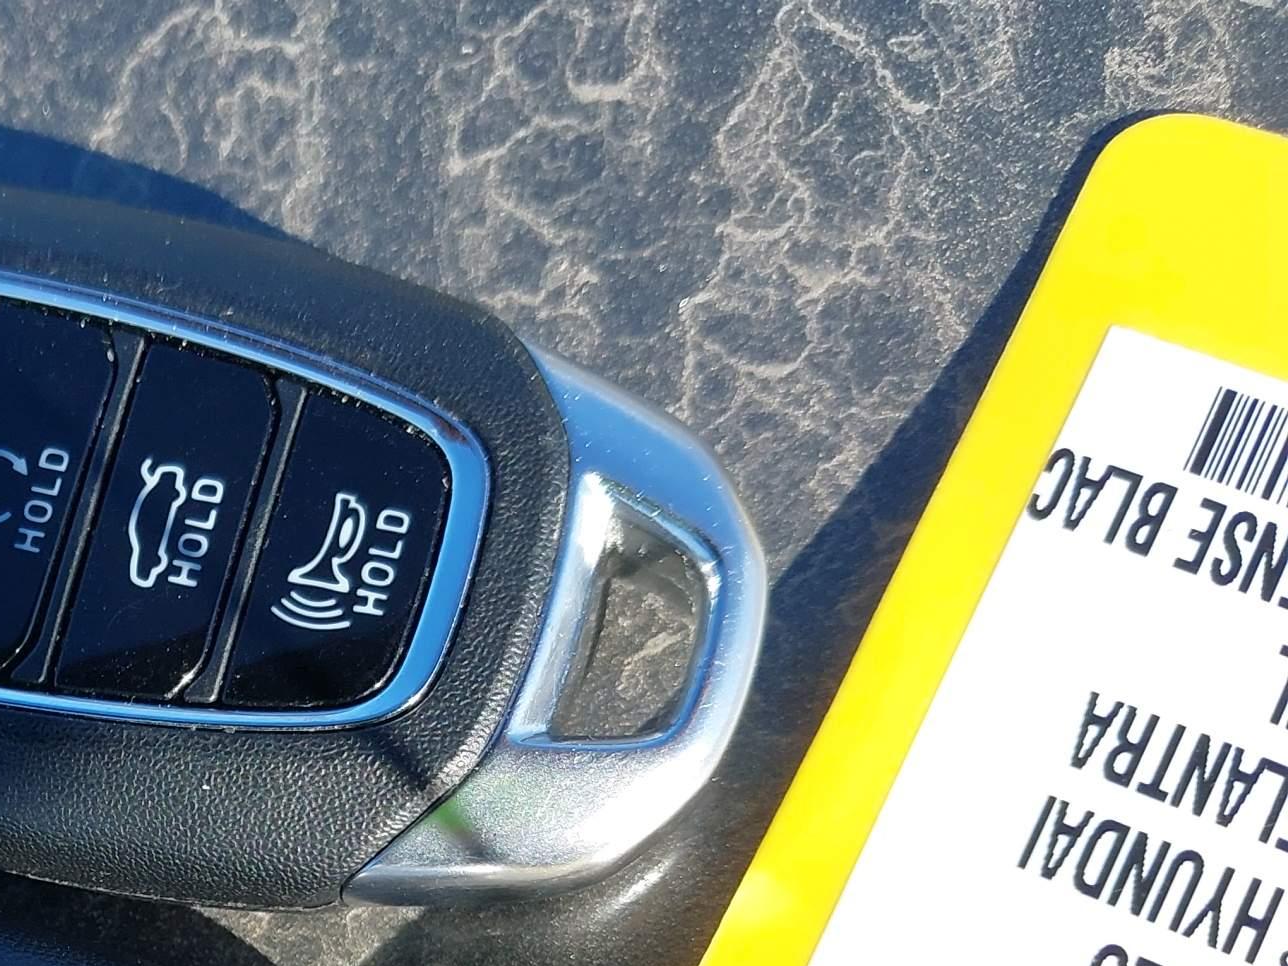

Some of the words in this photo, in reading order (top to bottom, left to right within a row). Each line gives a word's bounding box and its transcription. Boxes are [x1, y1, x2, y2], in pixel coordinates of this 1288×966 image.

[14, 447, 70, 553] HOLD
[167, 476, 225, 588] HOLD
[1024, 447, 1179, 557] BLAC
[1174, 497, 1288, 610] NSE
[352, 508, 411, 616] HOLD
[1071, 691, 1288, 853] LANTRA
[1017, 795, 1286, 965] HYUNDAI
